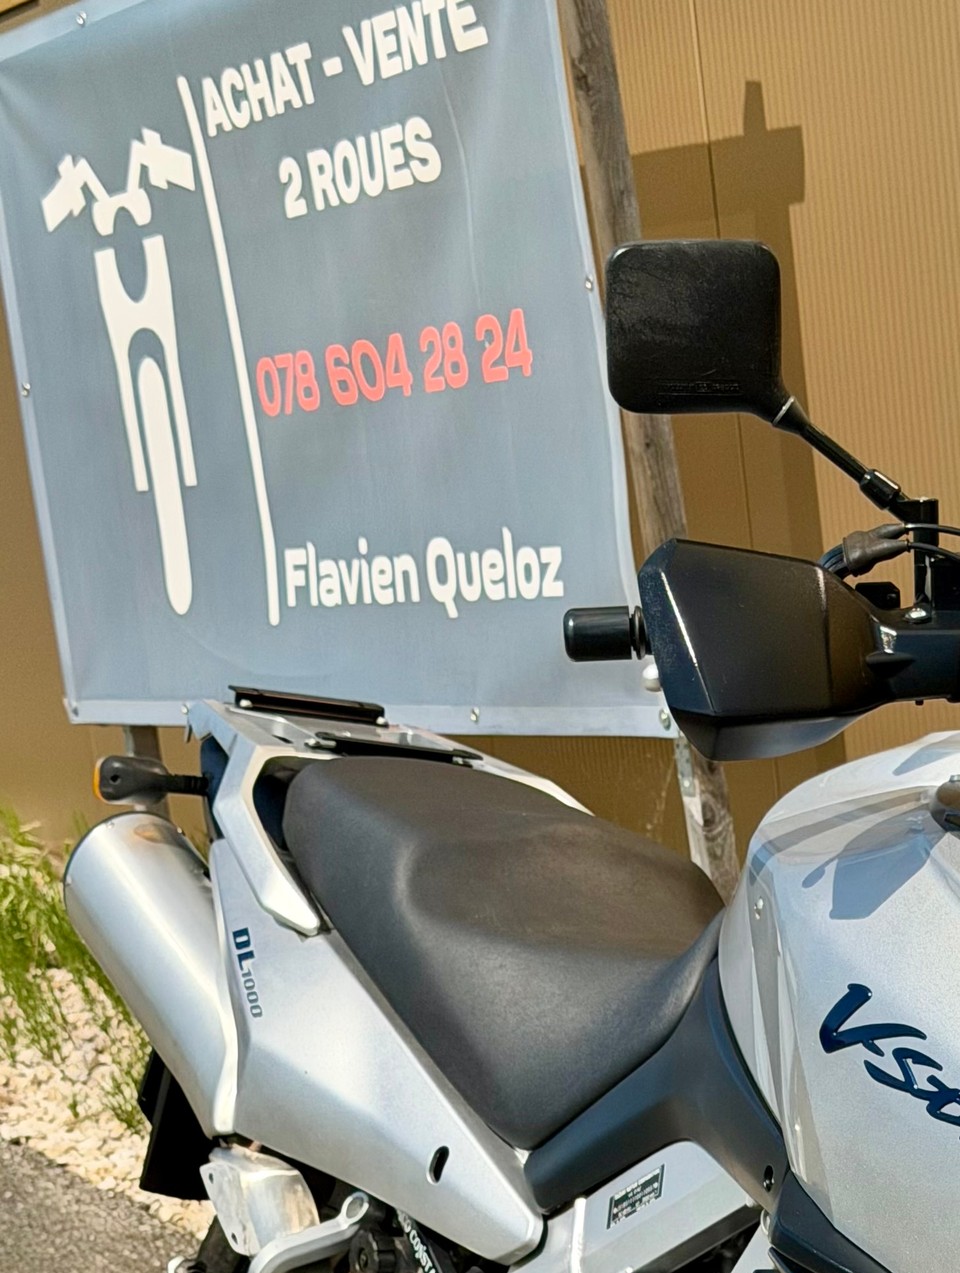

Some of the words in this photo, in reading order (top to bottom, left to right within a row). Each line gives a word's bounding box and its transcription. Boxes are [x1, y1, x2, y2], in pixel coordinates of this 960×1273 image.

[202, 42, 315, 137] ACHAT
[322, 56, 344, 77] -
[342, 0, 489, 86] VENTE
[279, 156, 309, 219] 2
[306, 116, 442, 211] ROUES
[256, 350, 320, 416] 078
[325, 333, 413, 406] 604
[419, 322, 469, 393] 28
[475, 308, 533, 383] 24
[284, 536, 421, 608] Flavien
[426, 526, 564, 618] Queloz
